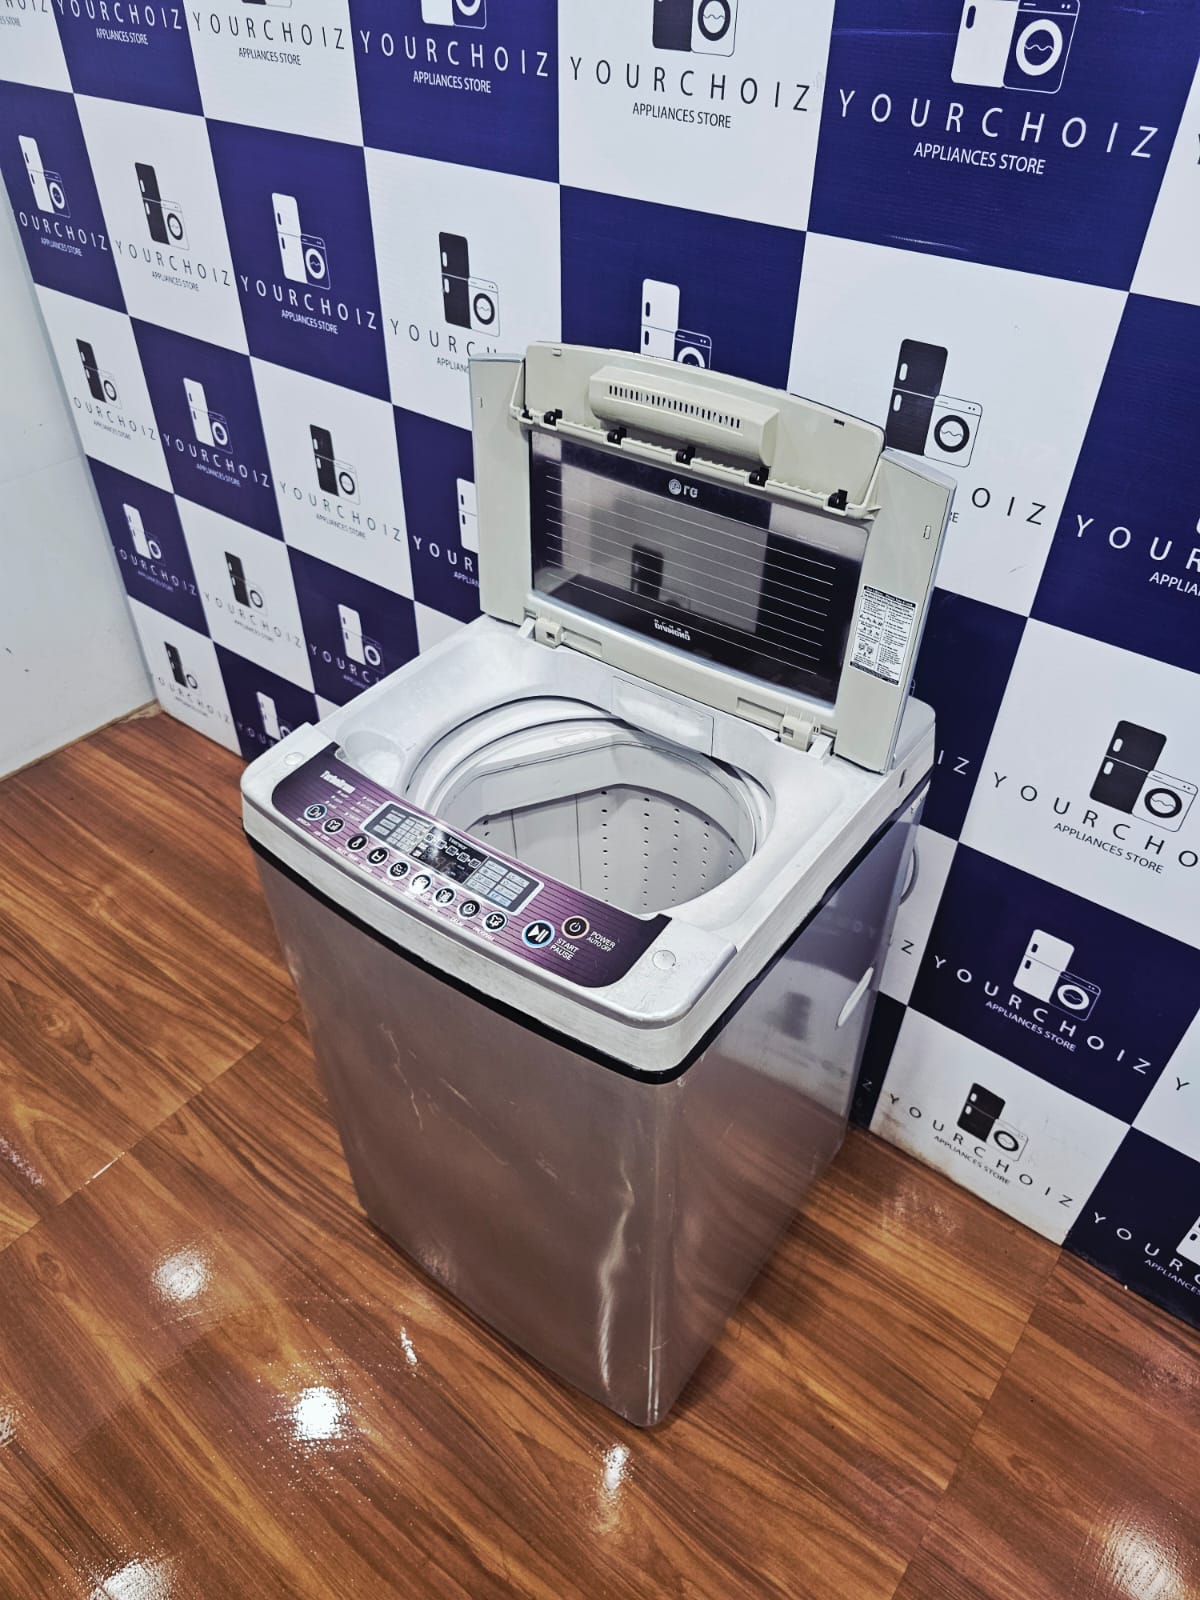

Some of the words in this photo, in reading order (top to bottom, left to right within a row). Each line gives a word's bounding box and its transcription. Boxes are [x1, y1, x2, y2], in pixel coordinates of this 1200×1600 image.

[96, 28, 129, 43] APPLIANCES
[129, 33, 149, 45] STORE
[194, 12, 345, 51] YOURCHOIZ
[239, 47, 279, 63] APPLIANCES
[279, 53, 301, 66] STORE
[360, 30, 549, 78] YOURCHOIZ
[413, 70, 462, 90] APPLIANCES
[463, 77, 491, 94] STORE
[570, 56, 810, 112] YOURCHOIZ
[632, 102, 695, 124] APPLIANCES
[697, 111, 731, 129] STORE
[839, 88, 1158, 158] YOURCHOIZ
[913, 142, 997, 169] APPLIANCES
[999, 154, 1046, 175] STORE
[115, 239, 231, 287] YOURCHOIZ
[240, 274, 377, 330] YOURCHOIZ
[281, 309, 316, 328] APPLIANCES
[317, 318, 338, 334] STORE
[163, 433, 270, 488] YOURCHOIZ
[280, 480, 401, 542] YOURCHOIZ
[1149, 571, 1200, 597] APPLIA
[1053, 822, 1124, 857] APPLIANCES
[1125, 851, 1164, 874] STORE
[550, 944, 574, 961] PAUSE
[556, 938, 580, 953] START
[586, 937, 602, 948] AUTO
[591, 931, 616, 948] POWER
[933, 955, 1151, 1075] YOURCHOIZ
[985, 1000, 1043, 1035] APPLIANCES
[1042, 1029, 1076, 1052] STORE
[888, 1093, 1073, 1208] YOURCHOIZ
[933, 1135, 983, 1172] APPLIANCES
[983, 1167, 1011, 1185] STORE
